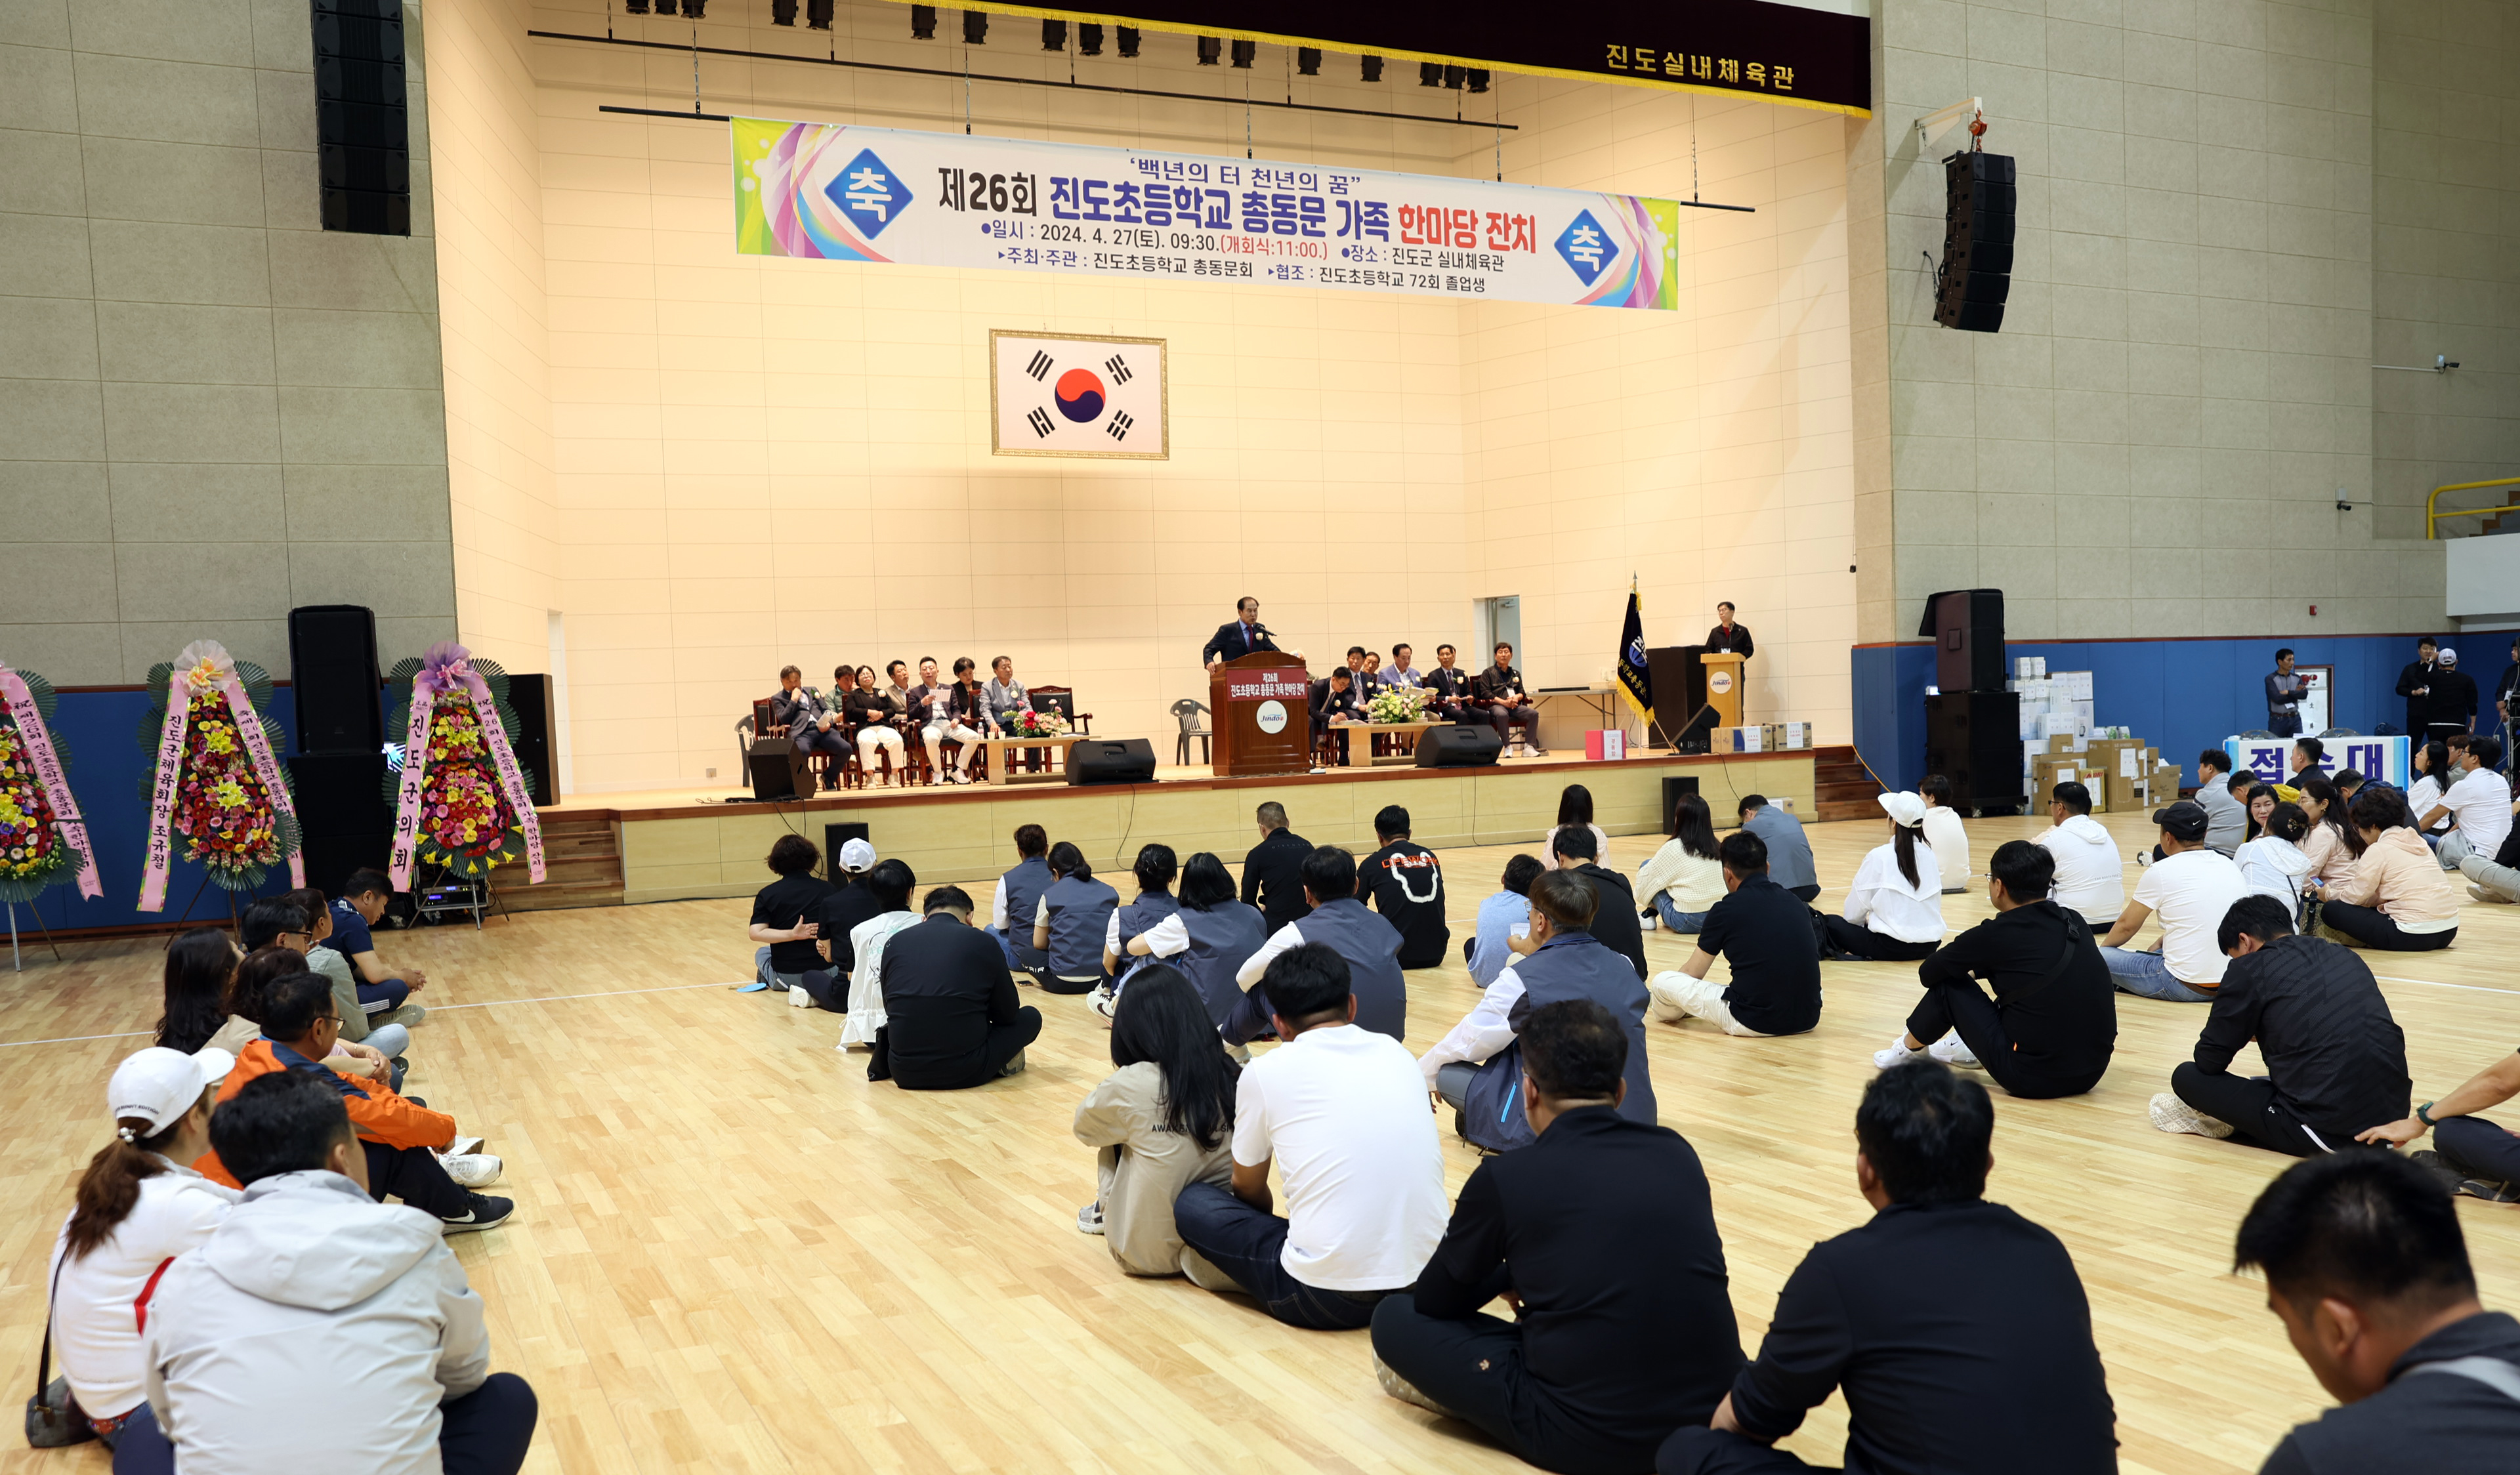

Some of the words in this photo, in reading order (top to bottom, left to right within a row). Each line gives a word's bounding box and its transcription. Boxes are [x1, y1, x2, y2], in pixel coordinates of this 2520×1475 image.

[1606, 43, 1795, 91] 진도실내체육관
[1220, 166, 1240, 186] 터
[1251, 167, 1318, 192] 천년의
[845, 167, 892, 223] 축
[938, 166, 1038, 217] 제26회
[1050, 176, 1232, 230] 진도초등학교
[1242, 190, 1326, 238] 총동문
[1336, 199, 1389, 242] 가족
[1398, 203, 1479, 249] 한마당
[1486, 211, 1537, 253] 잔치
[992, 219, 1024, 239] 일시
[1040, 224, 1087, 243] 2024.
[1093, 228, 1108, 244] 4.
[1113, 229, 1165, 249] 27(토).
[1568, 224, 1603, 273] 축
[1093, 252, 1188, 274] 진도초등학교
[1193, 259, 1253, 278] 총동문회
[1350, 244, 1379, 262] 장소
[1392, 247, 1433, 268] 진도군
[1437, 250, 1505, 272] 실내체육관
[1276, 264, 1305, 281] 협조
[1319, 267, 1404, 287] 진도초등학교
[1409, 273, 1440, 290] 72회
[1445, 275, 1486, 293] 졸업생
[1230, 684, 1260, 697] 진도초등학교
[1261, 683, 1274, 696] 총동문
[1275, 683, 1284, 696] 가족
[1284, 682, 1297, 696] 한마당
[1297, 682, 1305, 696] 잔치
[1263, 673, 1278, 683] 제26회
[150, 824, 168, 870] 조규철
